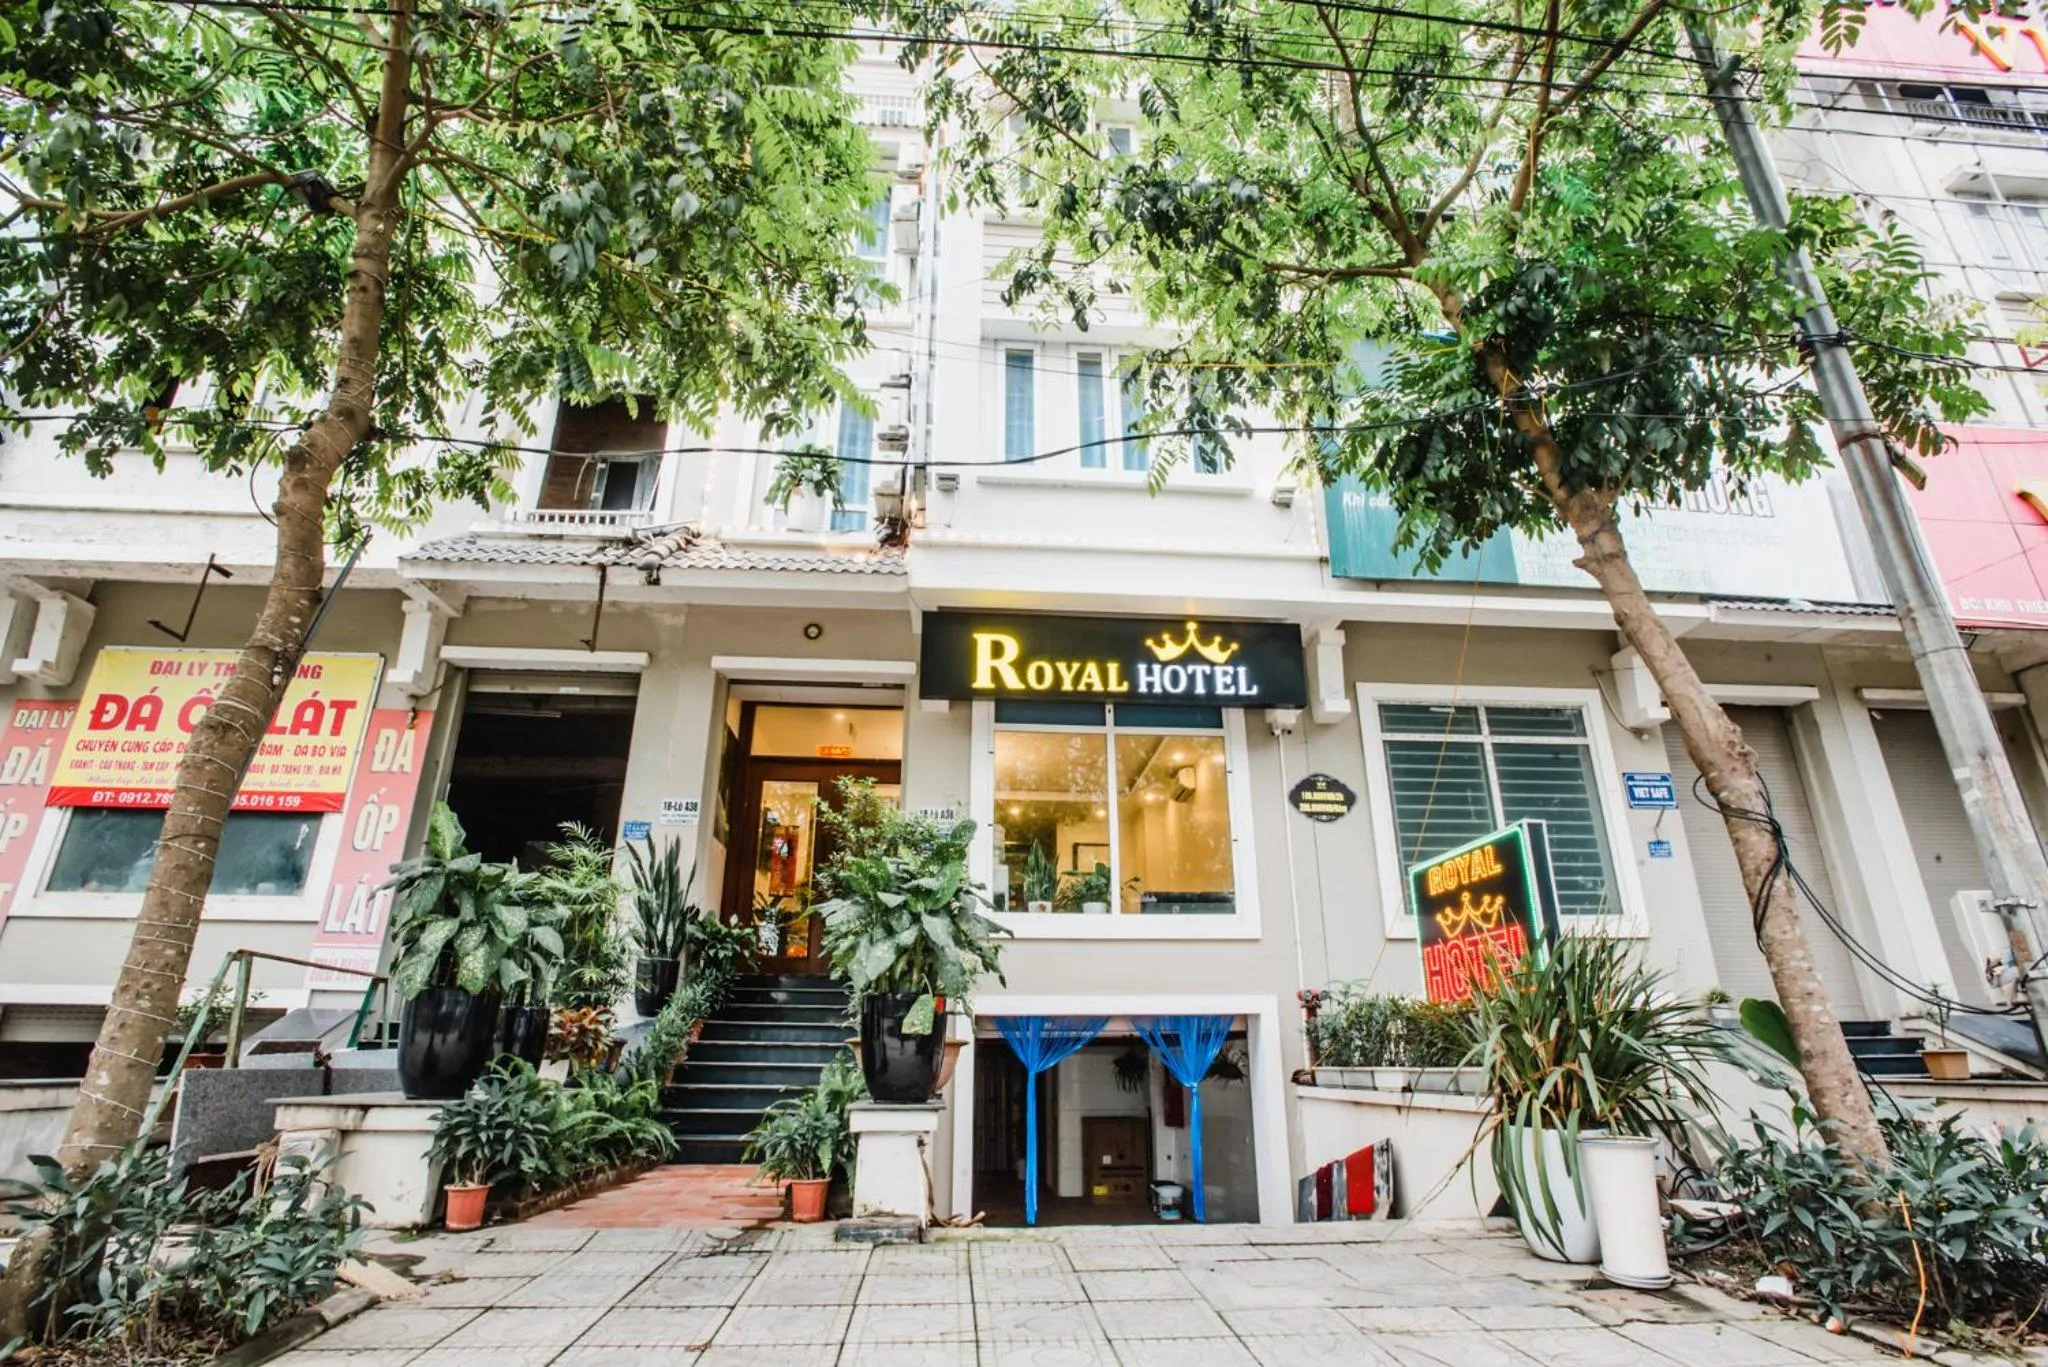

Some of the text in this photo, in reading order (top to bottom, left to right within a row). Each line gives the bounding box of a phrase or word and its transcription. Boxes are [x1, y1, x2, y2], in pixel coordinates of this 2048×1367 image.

[971, 632, 1258, 695] ROYAL HOTEL
[88, 682, 357, 737] ĐÁ Ố LÁT
[120, 740, 151, 753] CUNG
[351, 787, 400, 851] ỐP
[1427, 843, 1503, 897] ROYAL
